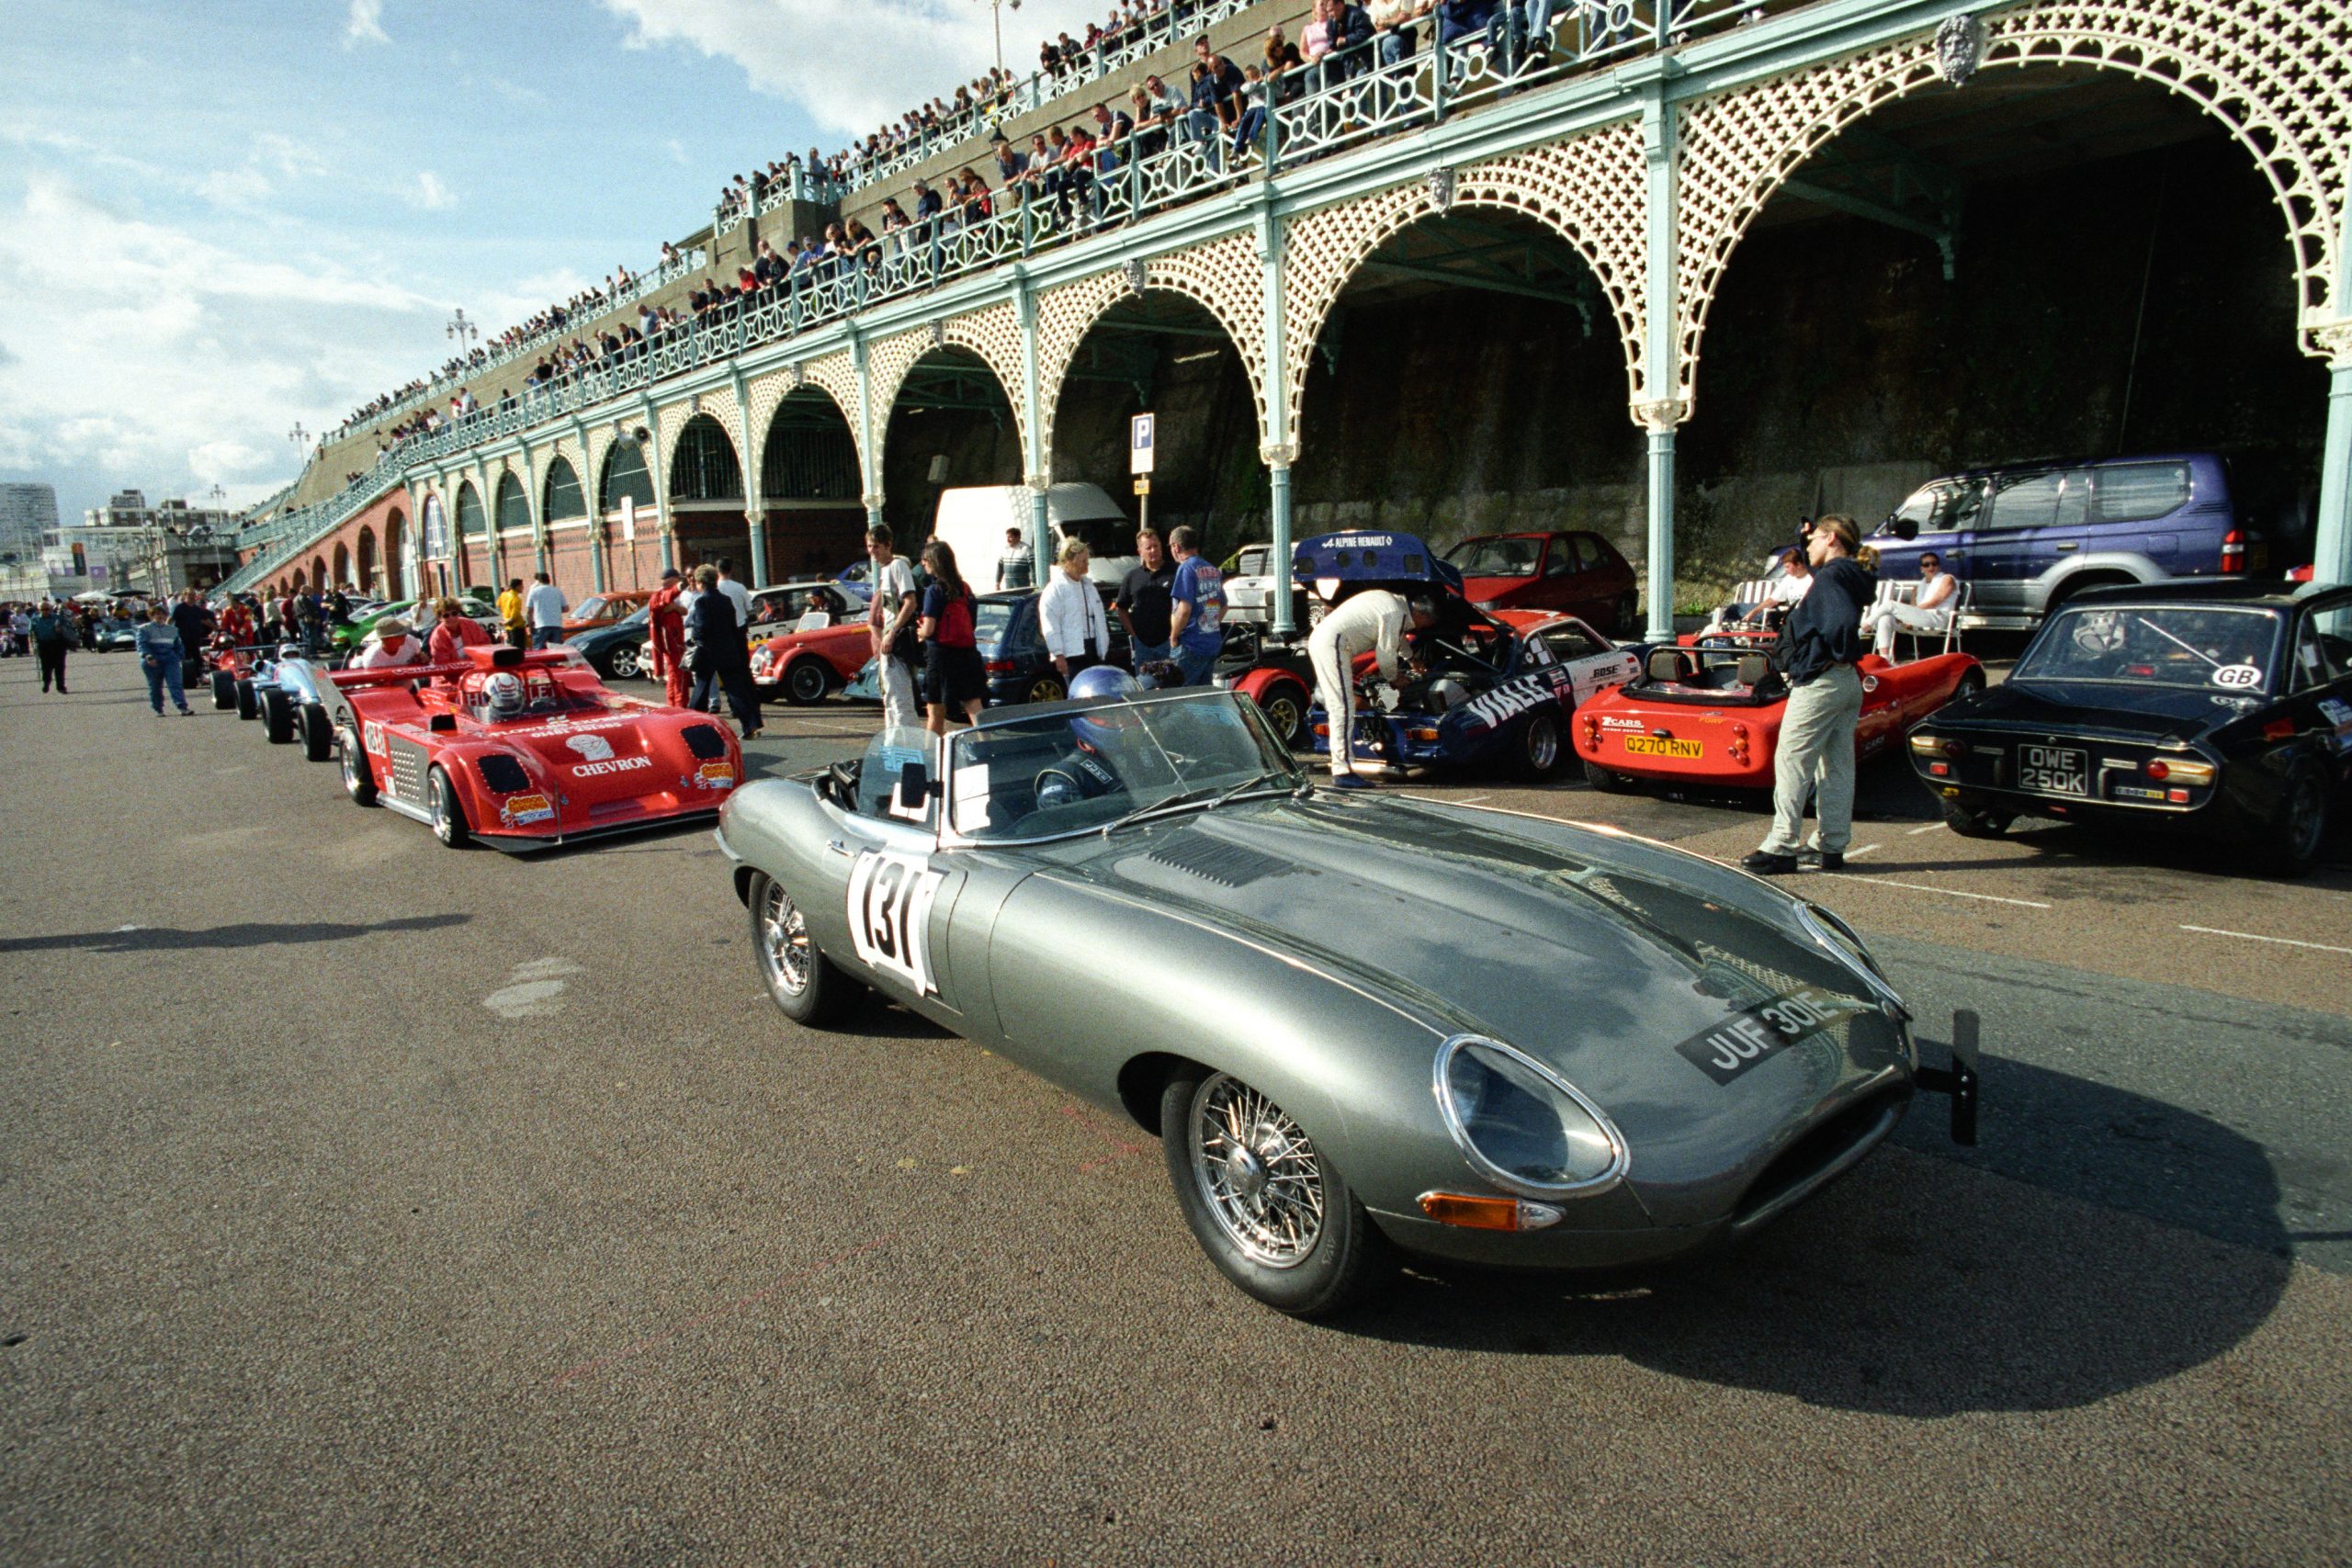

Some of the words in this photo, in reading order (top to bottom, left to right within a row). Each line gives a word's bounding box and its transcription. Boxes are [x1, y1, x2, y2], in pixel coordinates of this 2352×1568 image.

[1137, 419, 1149, 448] P
[1335, 536, 1357, 548] ALPINE
[1358, 536, 1385, 547] RENAULT
[1591, 663, 1620, 678] BOSE
[2218, 668, 2255, 685] GB
[1466, 674, 1556, 730] VIALLE
[1626, 737, 1667, 755] Q270
[1670, 739, 1702, 757] RNV
[571, 755, 653, 778] CHEVRON
[2030, 748, 2076, 771] OWE
[2021, 767, 2085, 794] 250K
[862, 855, 923, 970] 131
[1706, 1016, 1770, 1070] JUF
[1760, 990, 1840, 1034] 301E
